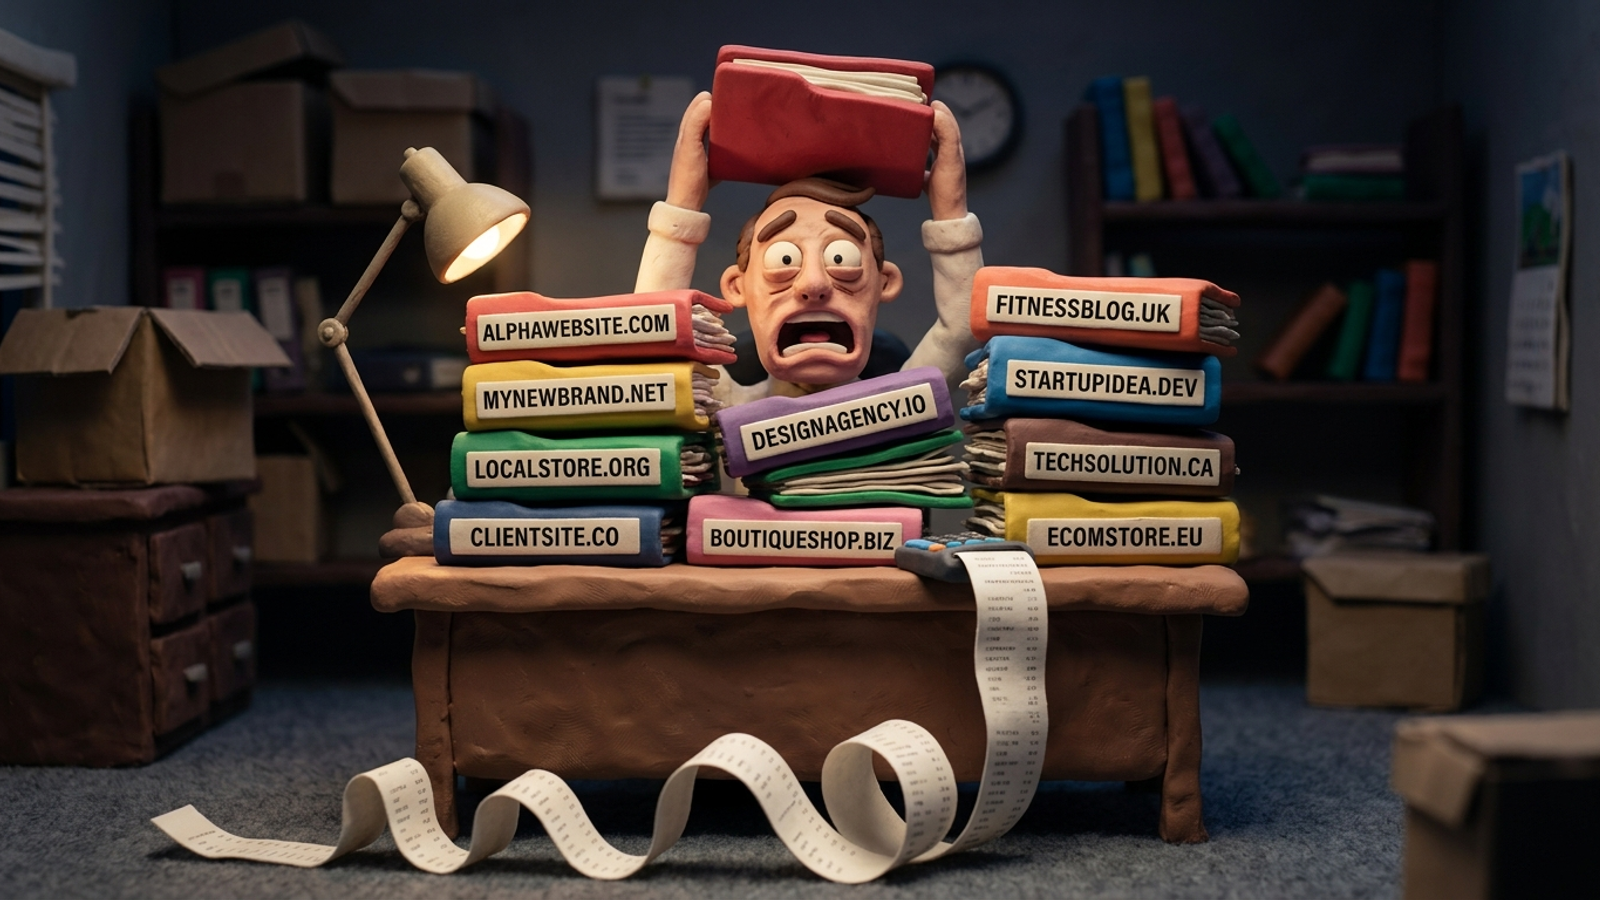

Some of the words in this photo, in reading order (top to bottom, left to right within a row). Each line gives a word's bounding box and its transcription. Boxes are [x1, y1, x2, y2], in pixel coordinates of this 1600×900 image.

[996, 295, 1171, 323] FITNESSBLOG.UK
[483, 314, 670, 342] ALPHAWEBSITE.COM
[484, 383, 668, 410] MYNEWBRAND.NET
[1015, 369, 1198, 398] STARTUPIDEA.DEV
[751, 394, 926, 451] DESIGNAGENCY.IO
[476, 457, 650, 480] LOCALSTORE.ORG
[1033, 451, 1214, 477] TECHSOLUTION.CA
[471, 526, 619, 548] CLIENTSITE.CO
[711, 529, 894, 551] BOUTIQUESHOP.BIZ
[1047, 527, 1203, 548] ECOMSTORE.EU
